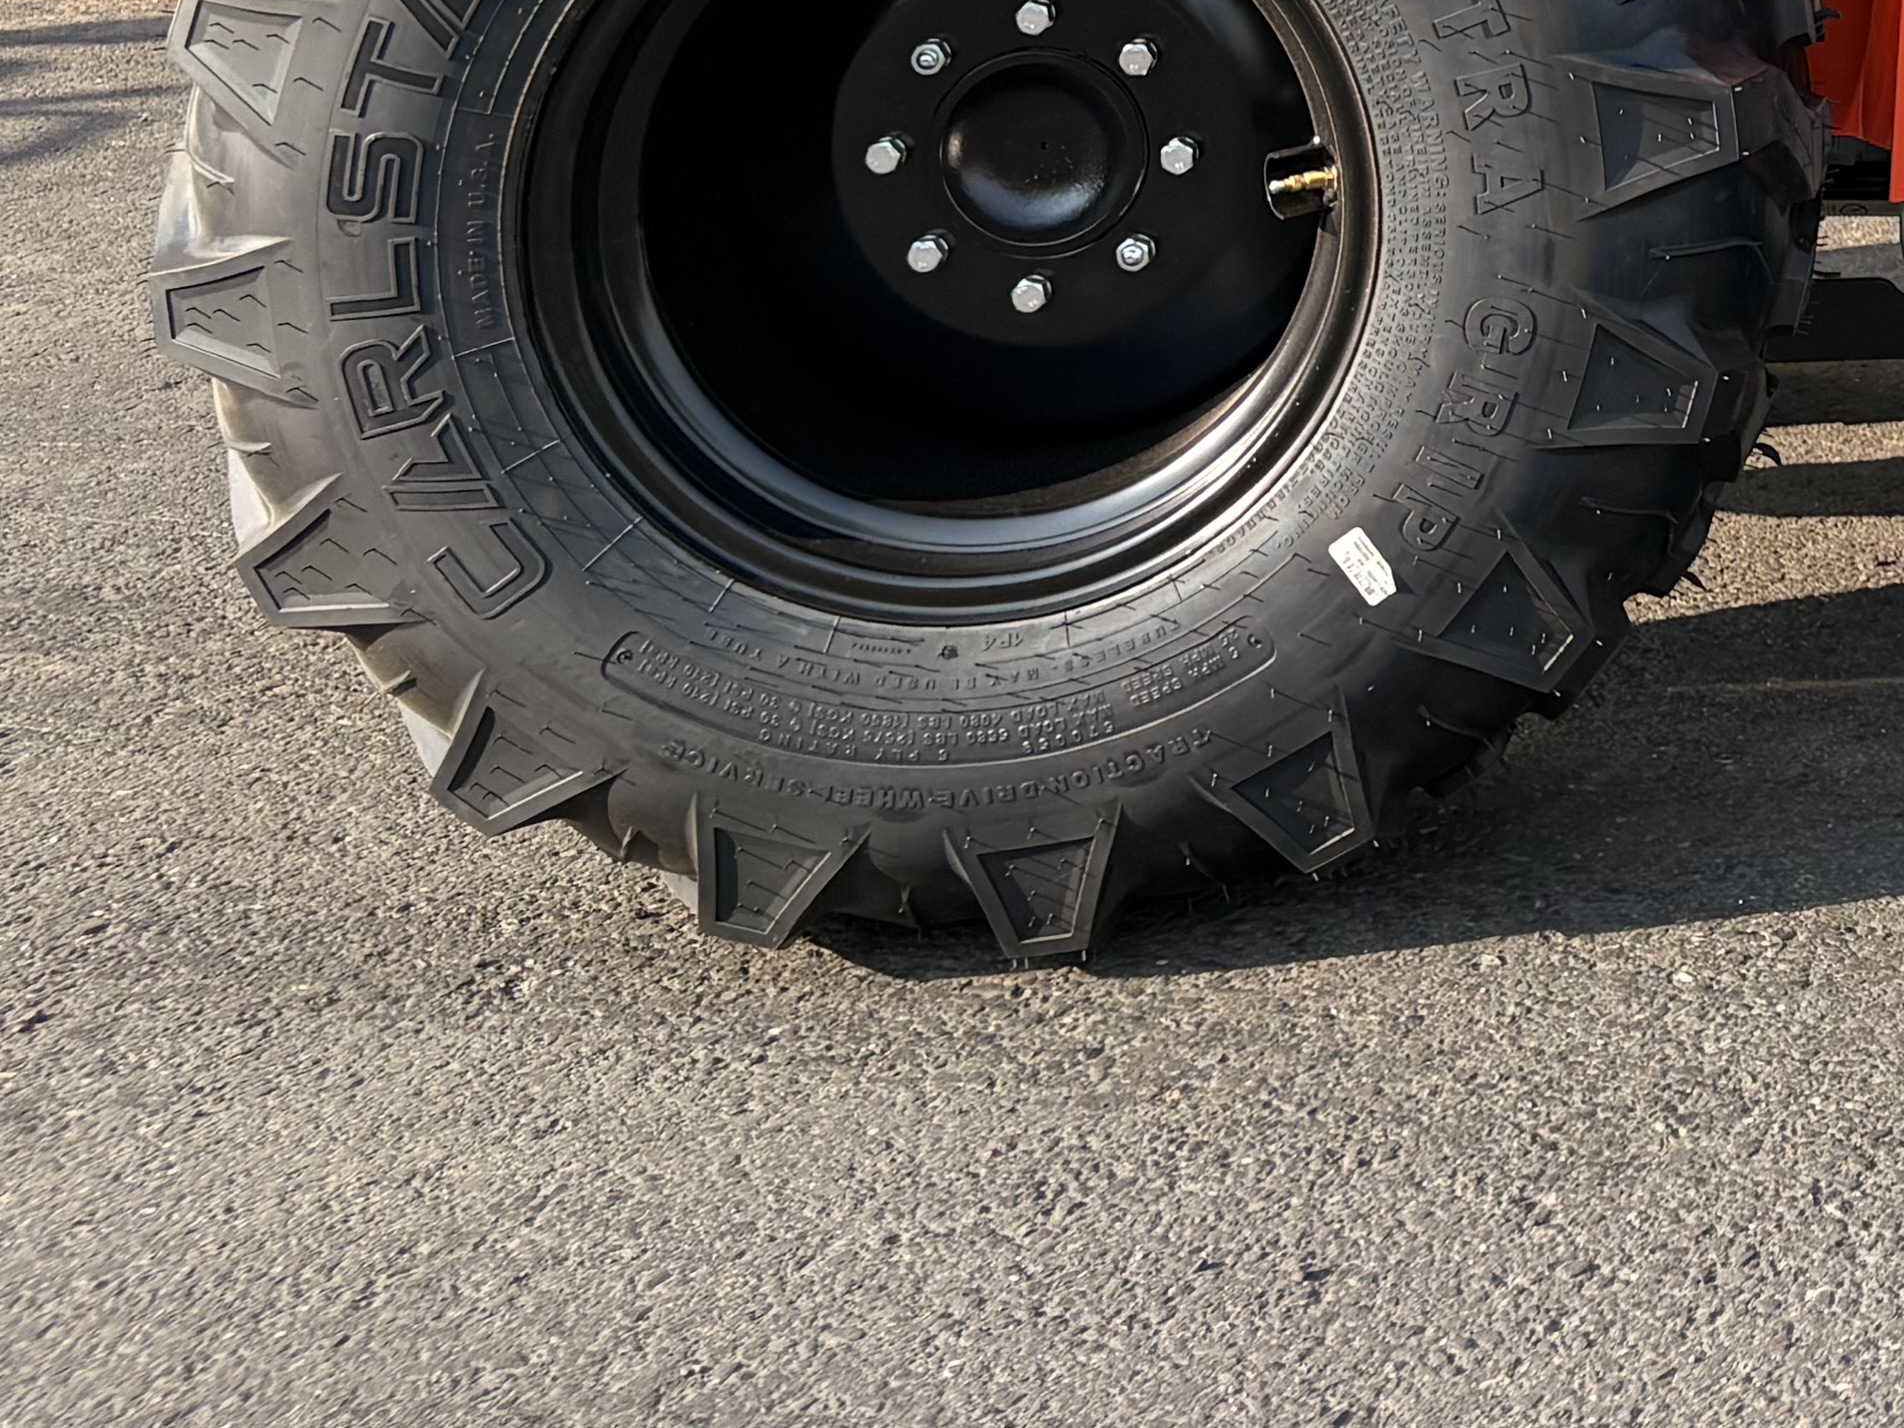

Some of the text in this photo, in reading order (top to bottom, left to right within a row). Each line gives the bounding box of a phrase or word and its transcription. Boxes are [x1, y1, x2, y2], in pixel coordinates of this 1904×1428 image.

[464, 219, 484, 244] IN
[464, 255, 498, 336] MADE
[1392, 297, 1537, 551] GRIP
[937, 777, 1044, 808] DRIVE
[1048, 724, 1213, 796] TRACTION
